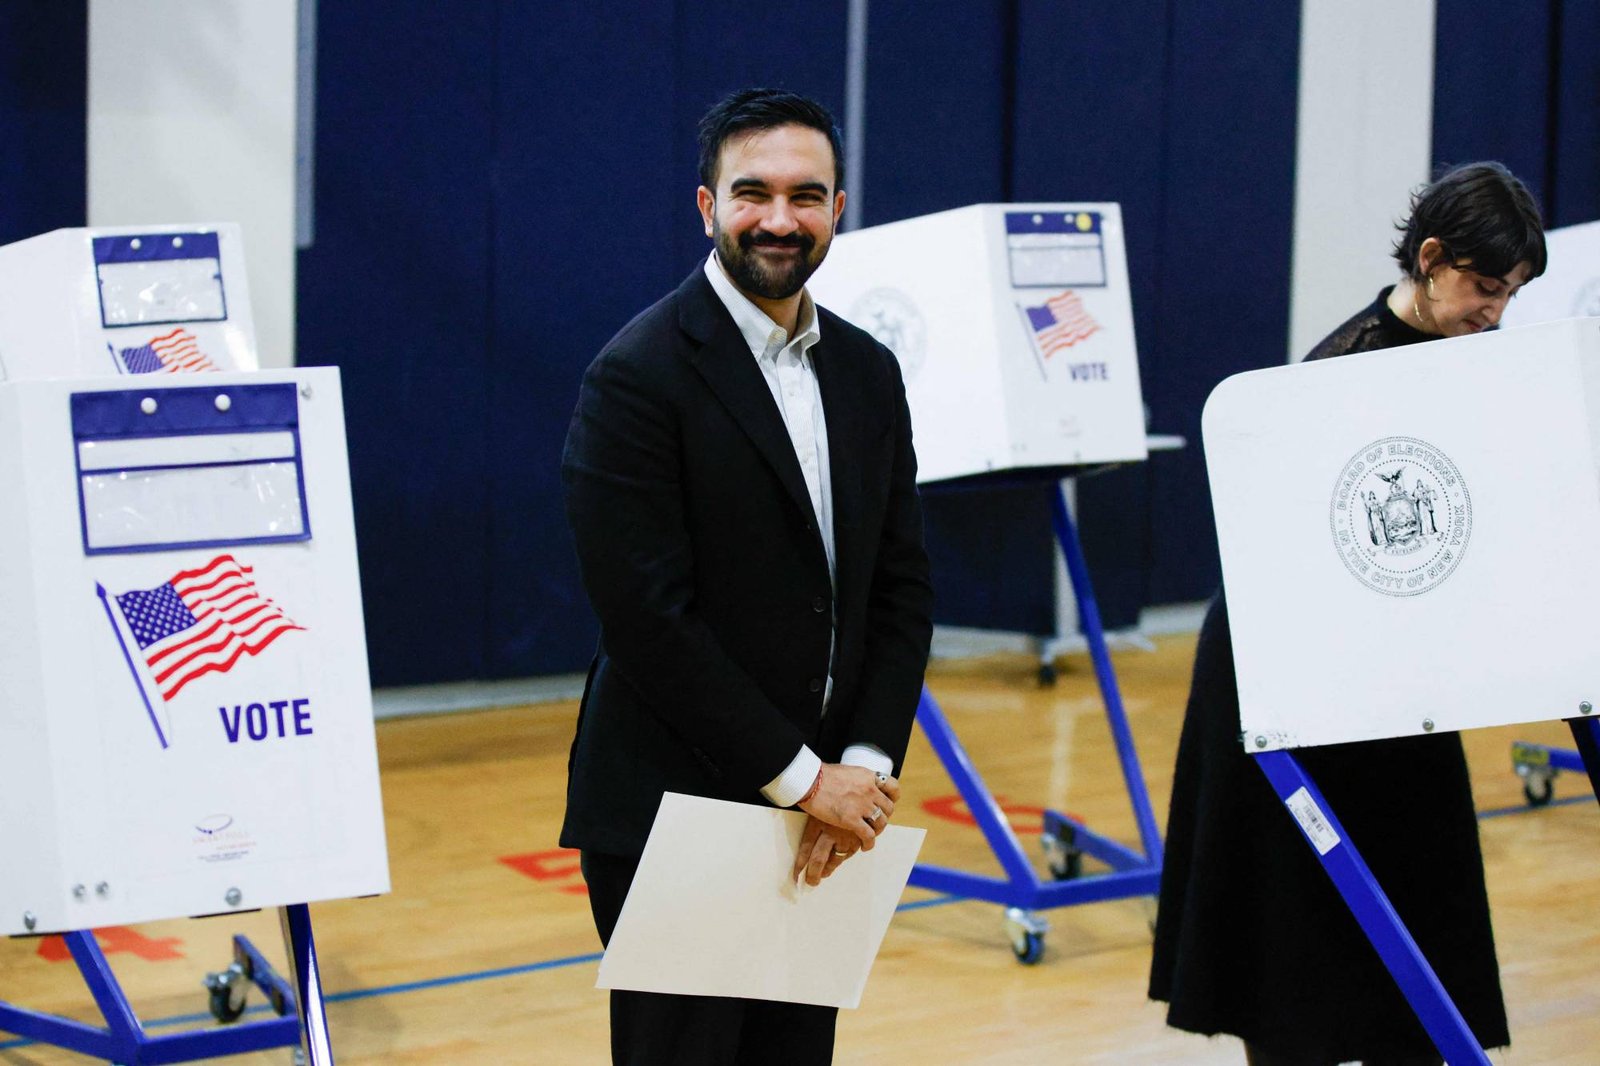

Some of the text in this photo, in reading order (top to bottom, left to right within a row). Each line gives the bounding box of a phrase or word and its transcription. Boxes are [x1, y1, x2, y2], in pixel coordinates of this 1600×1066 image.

[1337, 444, 1456, 511] BOARD OF ELECTIONS
[1338, 530, 1350, 546] IN
[1347, 547, 1370, 575] THE
[1371, 572, 1403, 589] CITY
[1407, 574, 1425, 588] OF
[1427, 550, 1454, 579] NEW
[1450, 504, 1465, 547] YORK
[219, 698, 313, 743] VOTE
